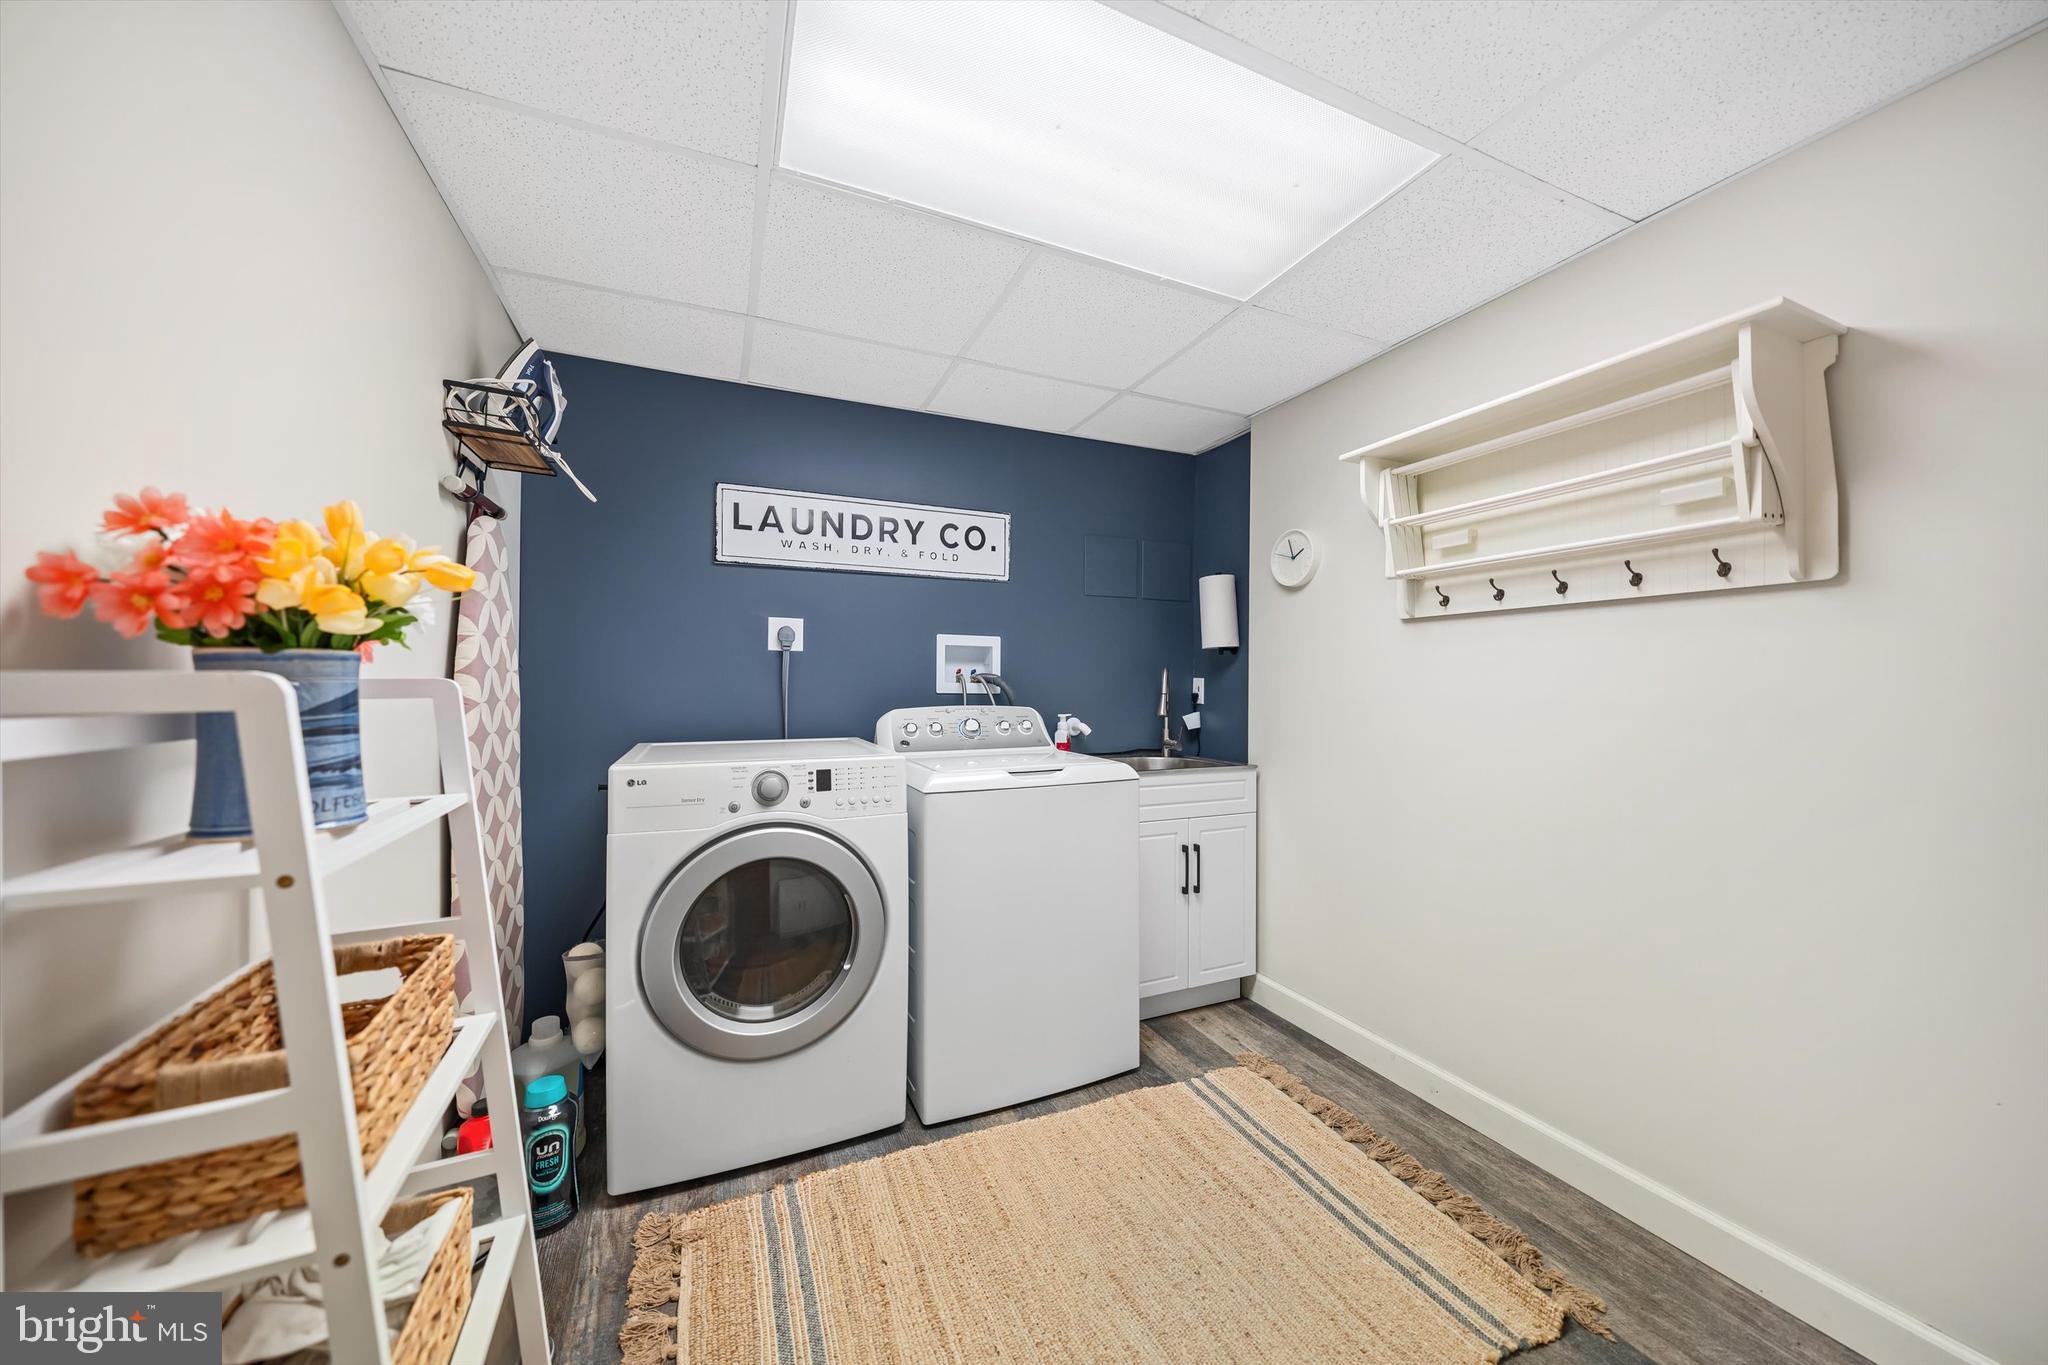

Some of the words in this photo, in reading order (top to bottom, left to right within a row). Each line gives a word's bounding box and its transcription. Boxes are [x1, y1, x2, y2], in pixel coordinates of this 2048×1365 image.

[733, 502, 925, 545] LAUNDRY
[940, 523, 996, 551] CO.
[781, 539, 839, 553] WASH,
[851, 545, 890, 557] DRY,
[901, 549, 908, 558] &
[919, 551, 959, 562] FOLD
[536, 1155, 559, 1170] FRESH
